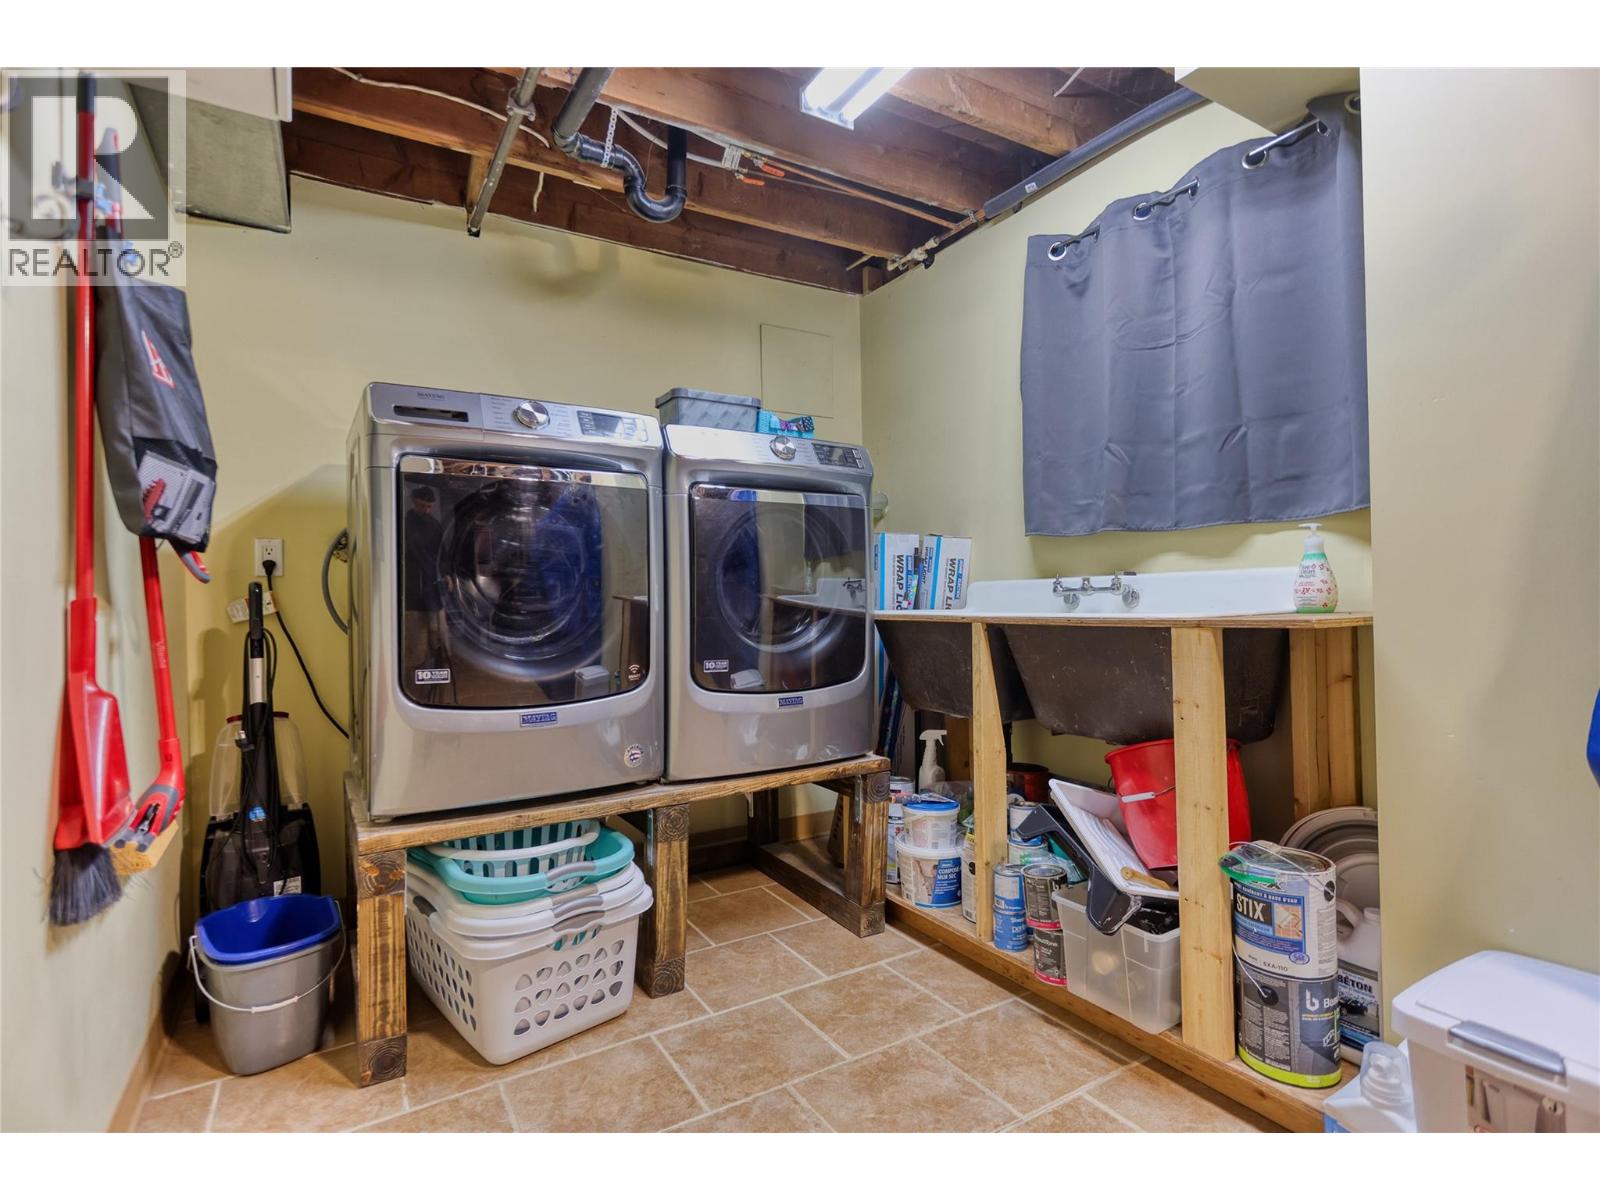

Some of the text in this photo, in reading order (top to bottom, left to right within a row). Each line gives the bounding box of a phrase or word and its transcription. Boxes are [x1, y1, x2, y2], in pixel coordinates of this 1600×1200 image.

[896, 554, 904, 590] WRAP
[947, 558, 956, 593] WRAP
[417, 671, 431, 680] 10
[1236, 893, 1265, 922] STIX
